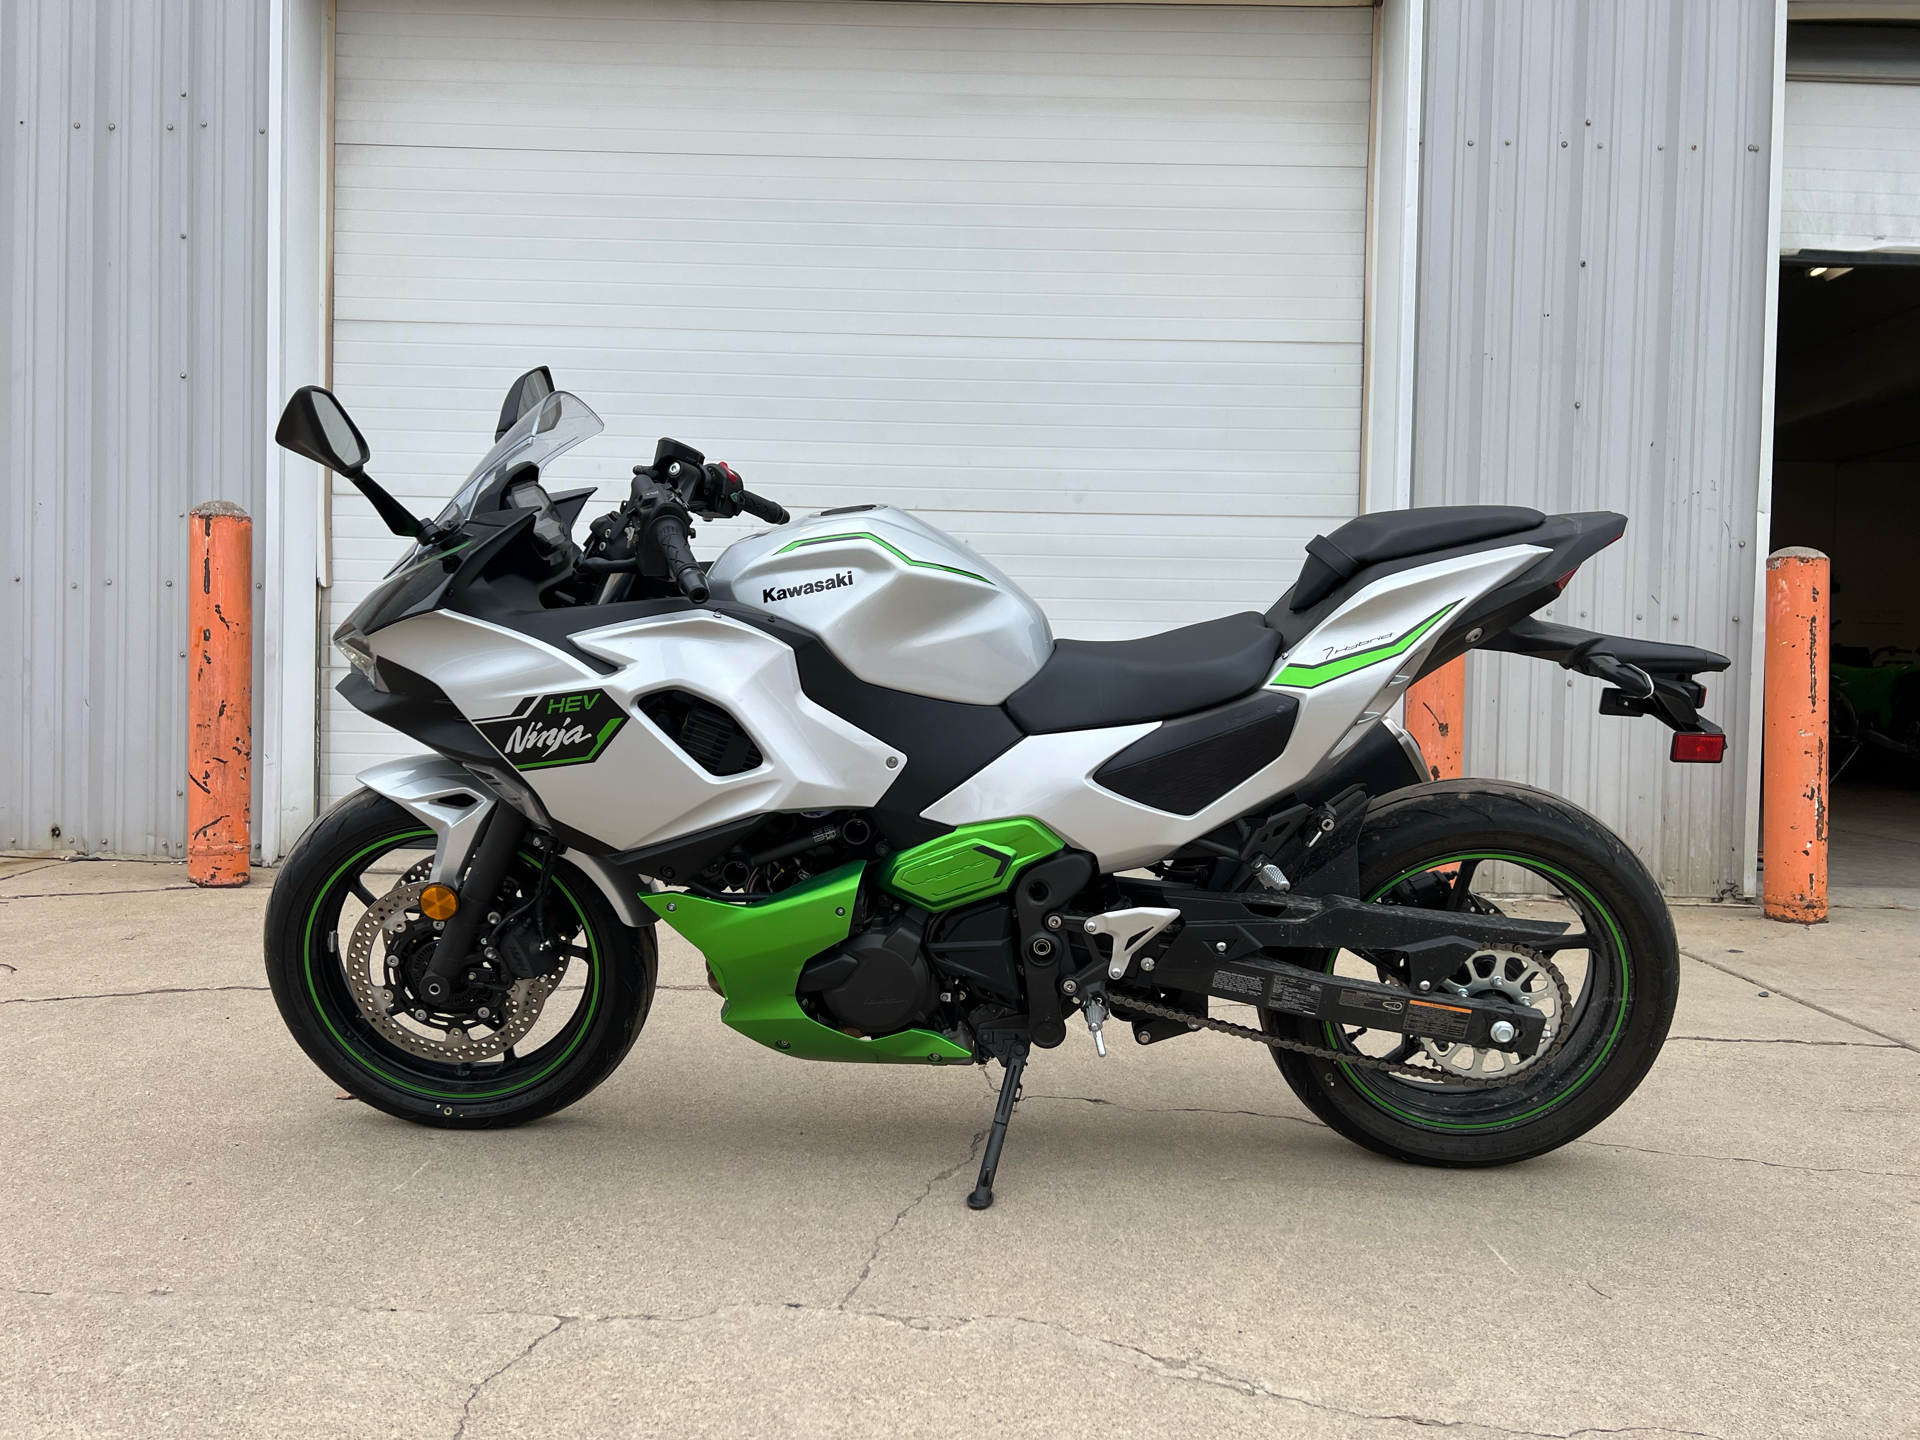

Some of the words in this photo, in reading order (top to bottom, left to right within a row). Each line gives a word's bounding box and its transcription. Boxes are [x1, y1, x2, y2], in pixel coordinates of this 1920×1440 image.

[763, 571, 853, 603] Kawasaki
[547, 693, 601, 715] HEV
[504, 717, 592, 758] Ninja
